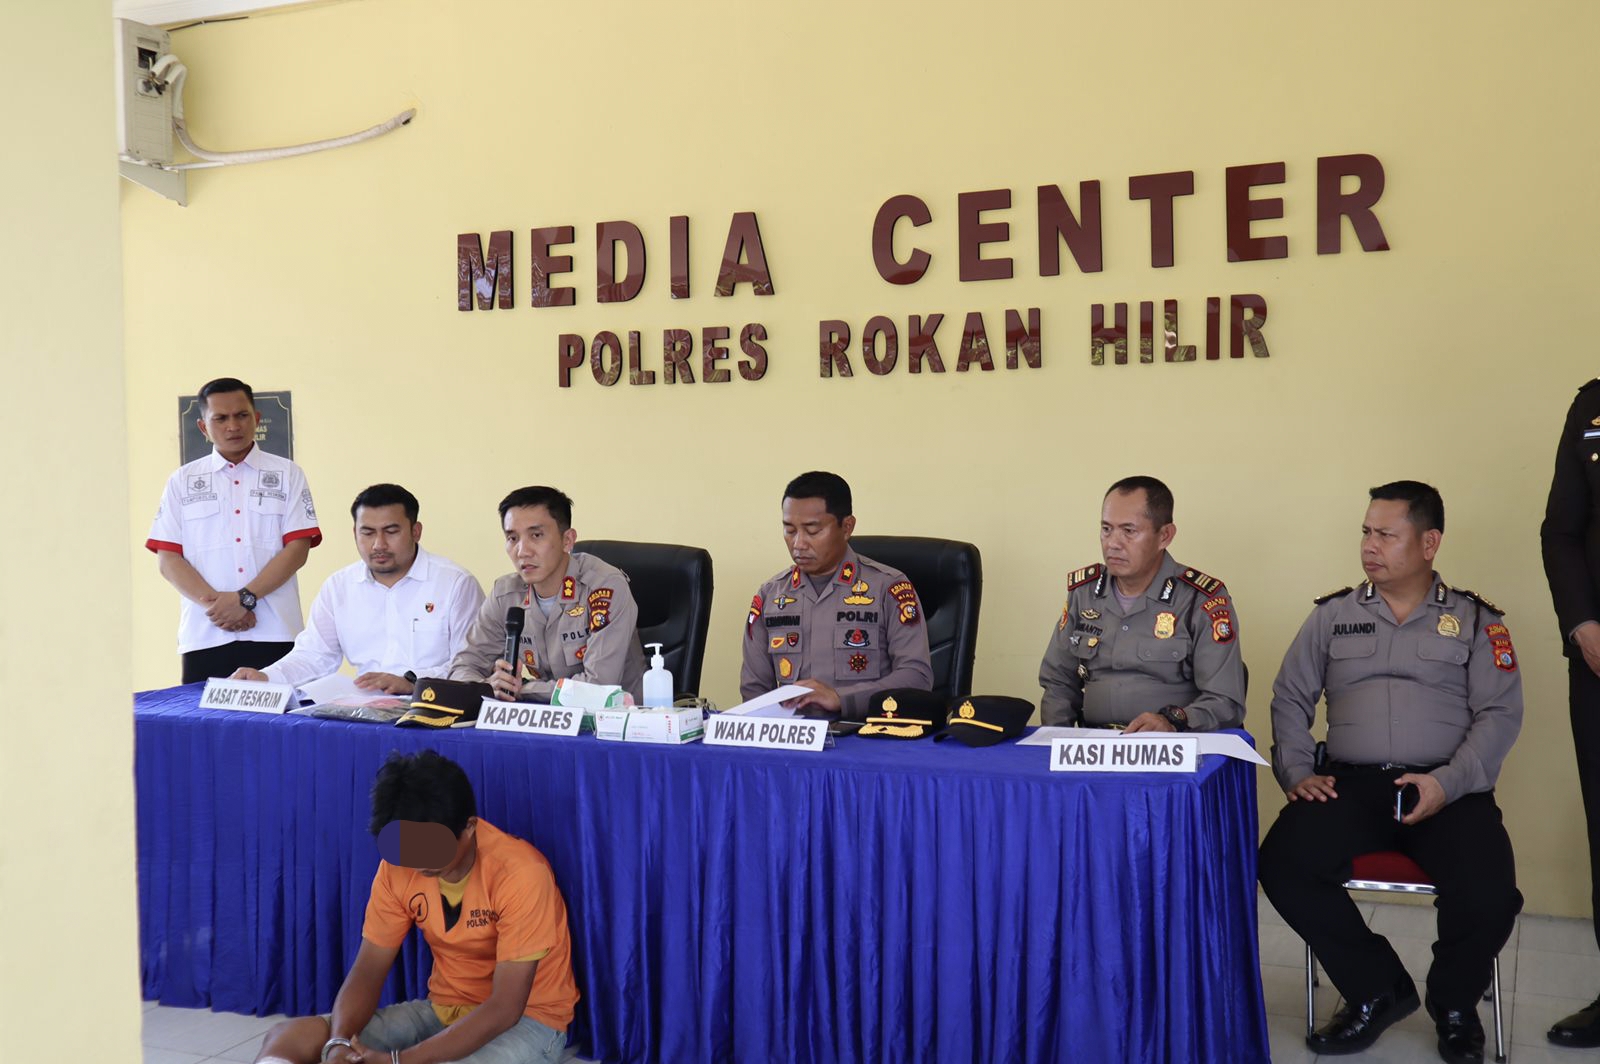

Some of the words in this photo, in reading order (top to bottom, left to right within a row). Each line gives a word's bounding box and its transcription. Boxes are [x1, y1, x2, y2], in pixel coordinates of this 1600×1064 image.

[457, 212, 775, 311] MEDIA
[872, 154, 1391, 285] CENTER
[558, 323, 768, 388] POLRES
[820, 308, 1042, 378] ROKAN
[1091, 294, 1270, 366] HILIR
[837, 611, 878, 623] POLRI
[1332, 622, 1376, 635] JULIANDI
[206, 687, 239, 704] KASAT
[240, 689, 282, 708] RESKRIM
[483, 706, 573, 730] KAPOLRES
[713, 720, 757, 742] WAKA
[758, 722, 816, 745] POLRES
[1059, 744, 1105, 765] KASI
[1111, 744, 1184, 766] HUMAS
